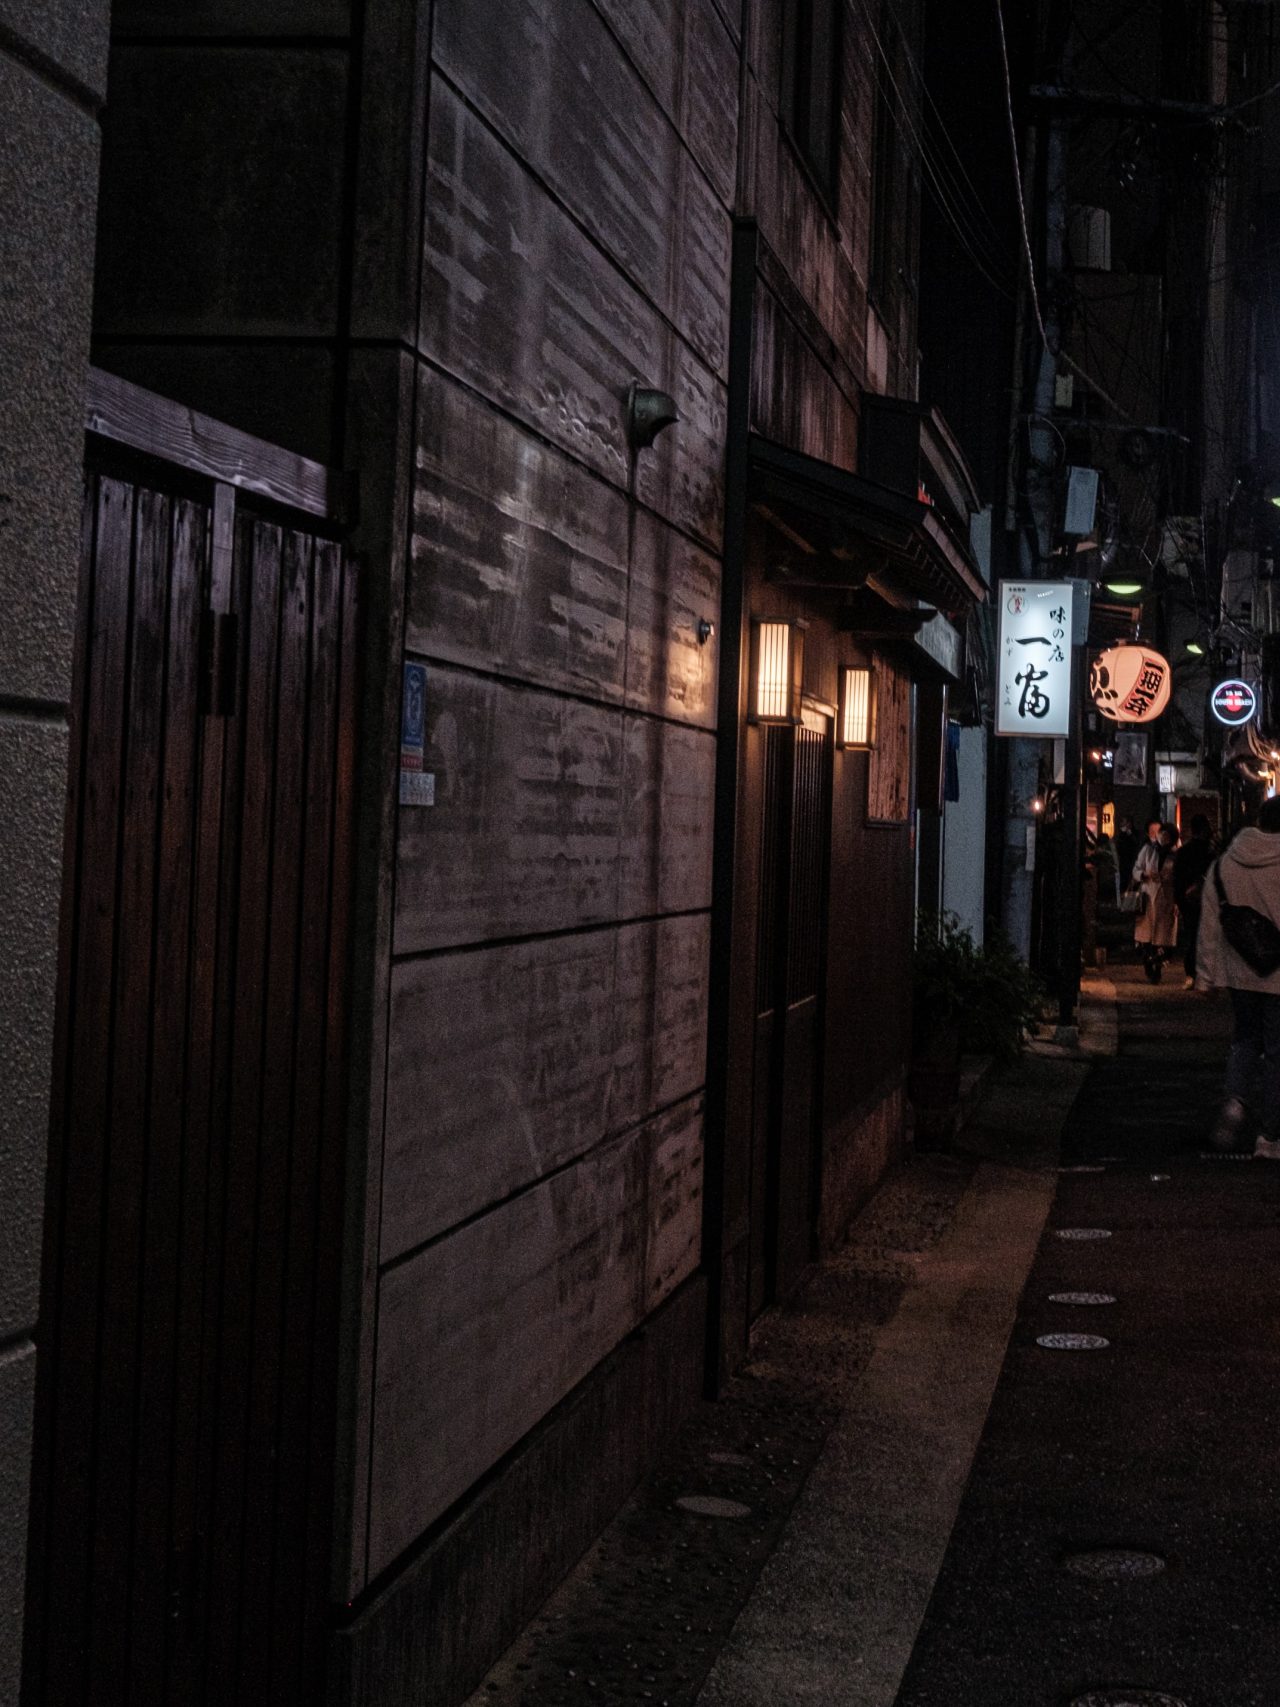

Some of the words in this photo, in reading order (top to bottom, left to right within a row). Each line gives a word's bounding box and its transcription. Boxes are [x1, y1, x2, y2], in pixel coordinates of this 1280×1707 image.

[1048, 606, 1066, 662] 味の店
[1014, 637, 1052, 719] 一富
[1124, 661, 1164, 716] 一期一会
